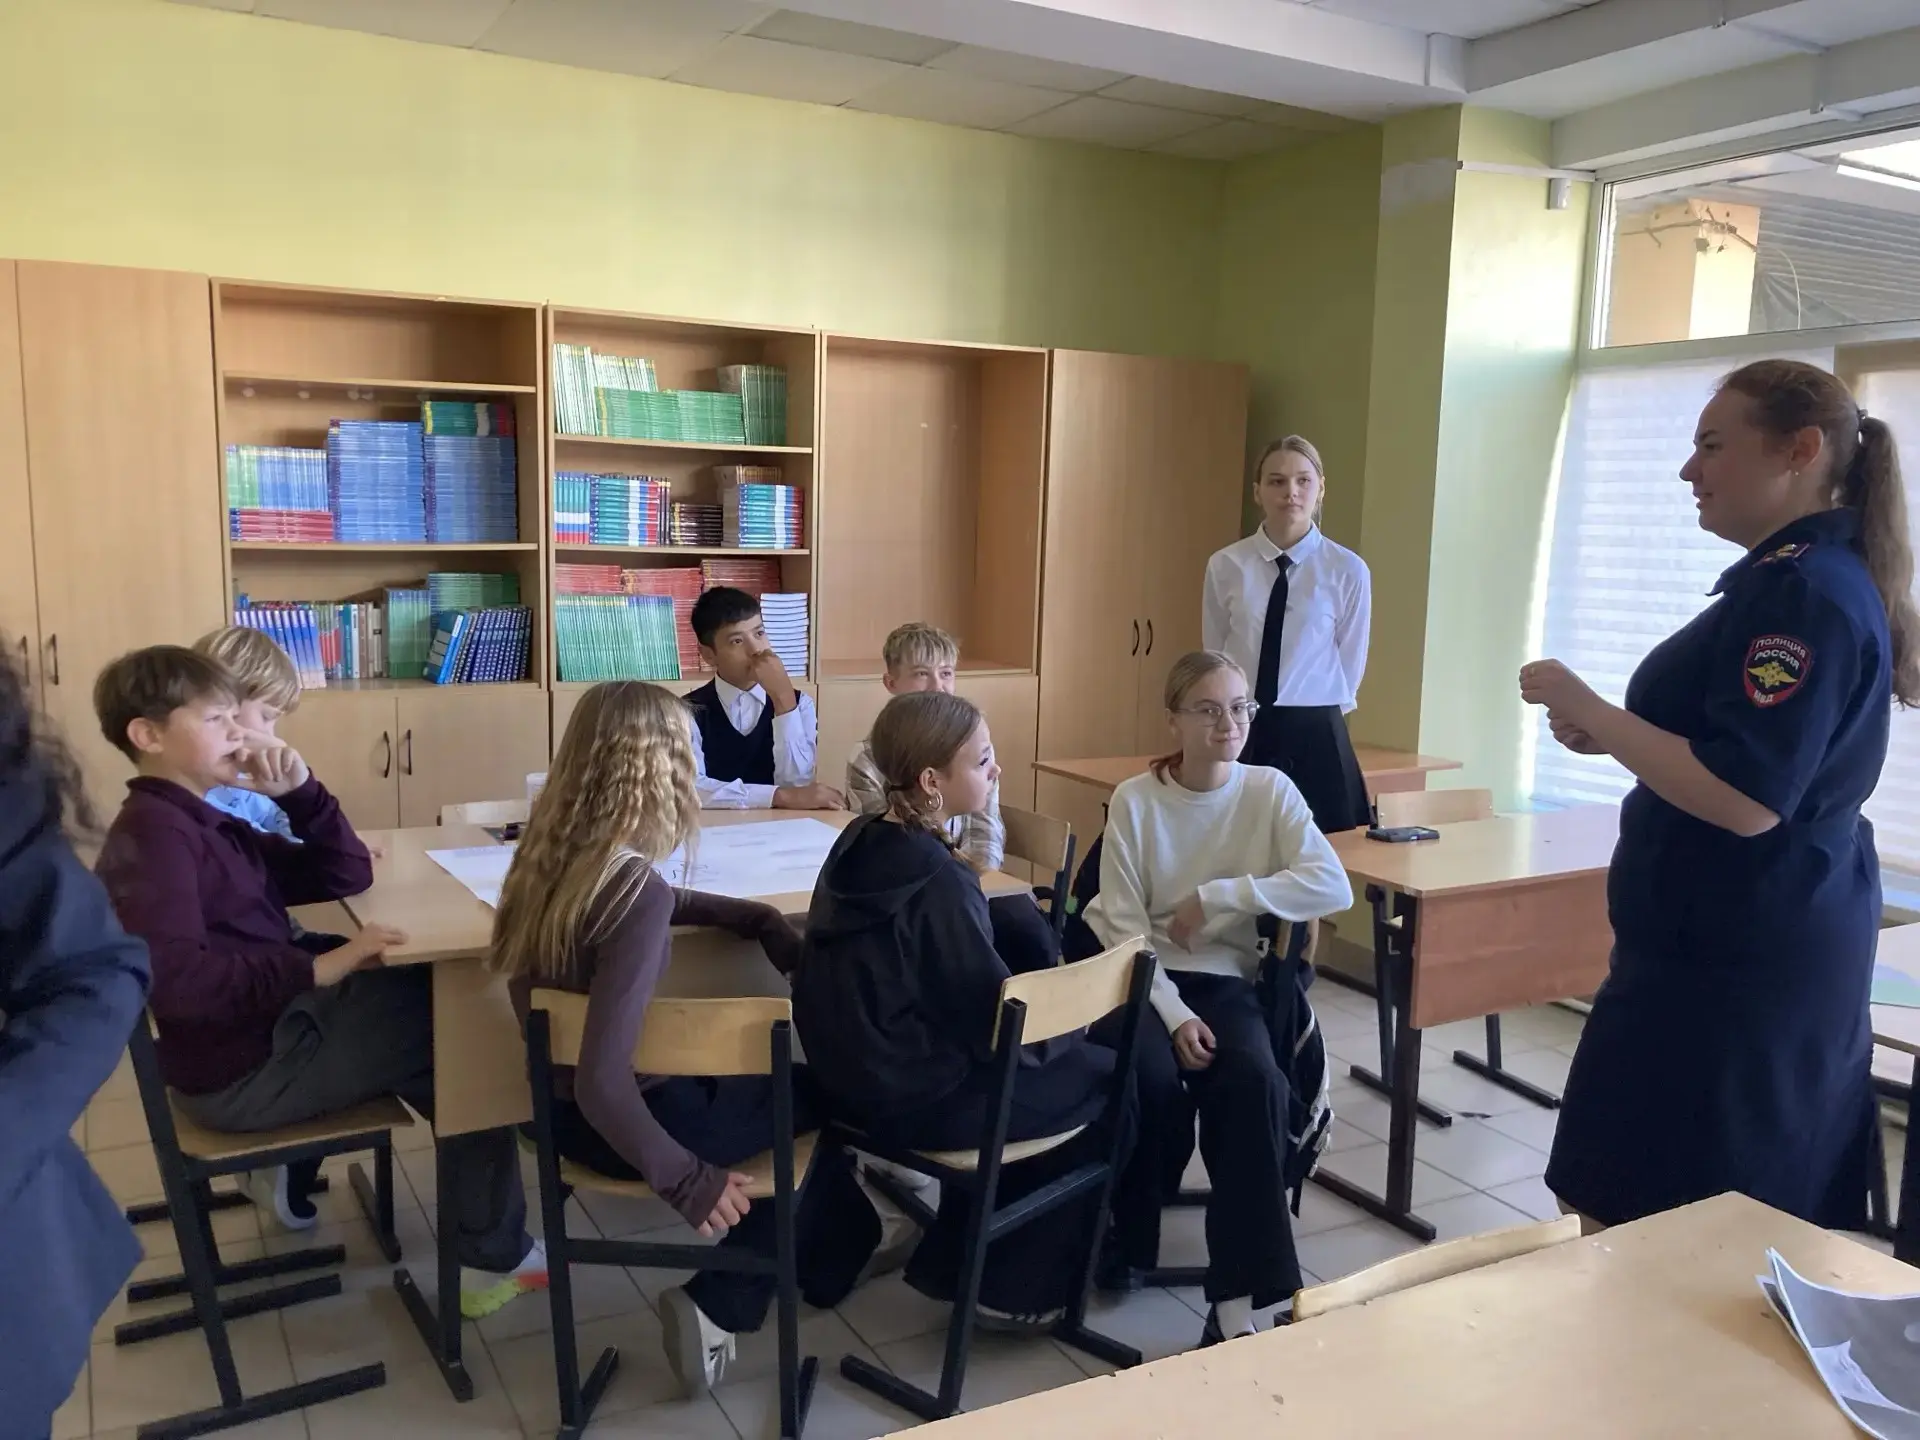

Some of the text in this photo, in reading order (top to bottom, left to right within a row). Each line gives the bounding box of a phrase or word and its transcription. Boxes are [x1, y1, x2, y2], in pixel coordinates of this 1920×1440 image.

[1756, 638, 1806, 658] ПОЛИЦИЯ
[1755, 649, 1800, 670] РОССИЯ
[1753, 690, 1775, 704] МВД
